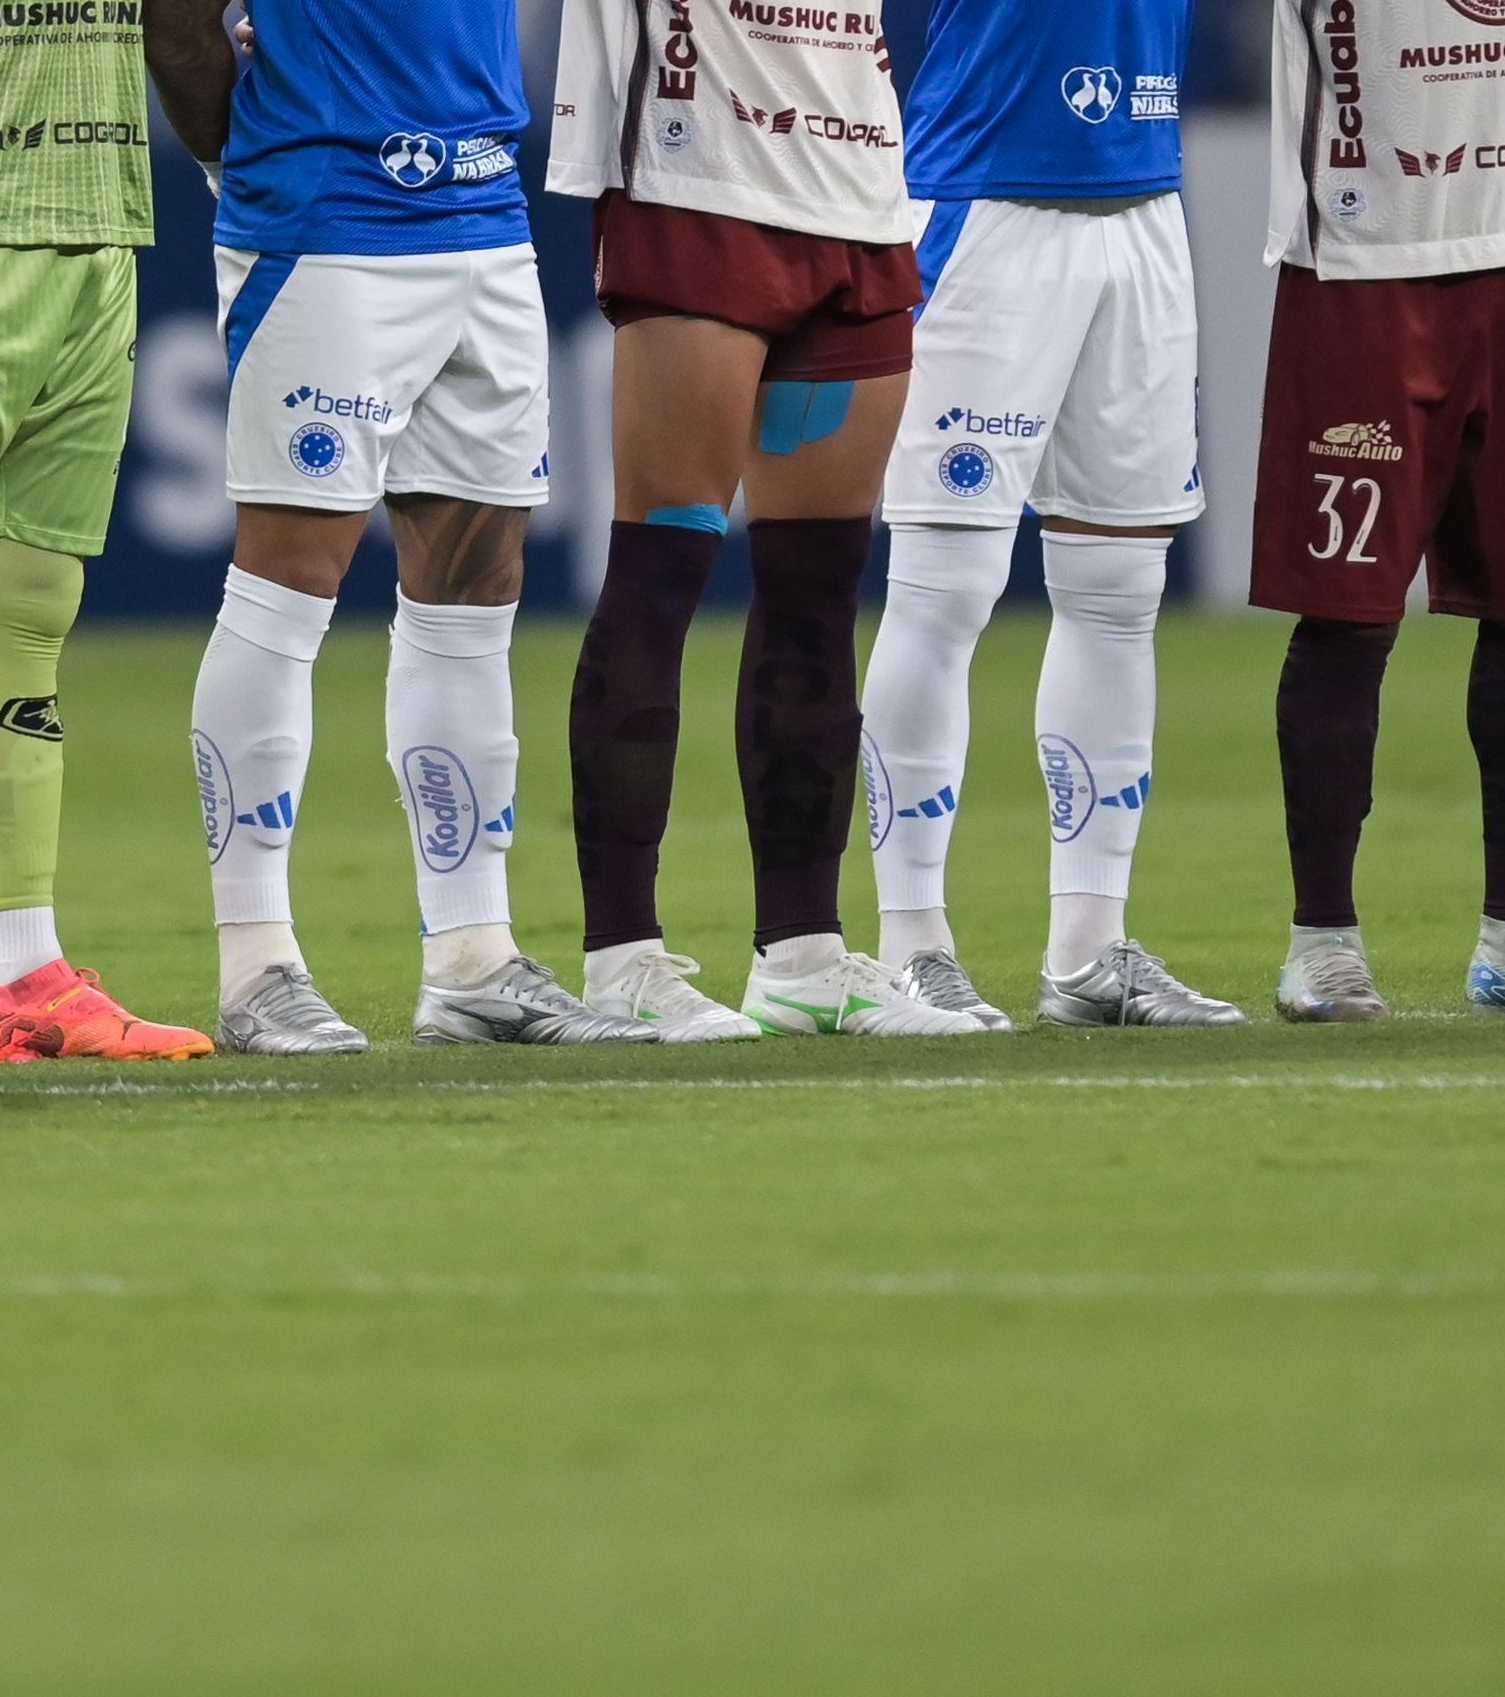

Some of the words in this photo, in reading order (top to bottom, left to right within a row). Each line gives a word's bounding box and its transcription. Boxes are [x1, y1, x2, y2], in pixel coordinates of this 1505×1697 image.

[844, 13, 875, 36] RU
[1422, 72, 1485, 84] COOPERATIVA
[314, 387, 393, 425] betfair
[296, 424, 340, 443] CRUZEIRO
[965, 408, 1047, 438] betfair
[291, 443, 321, 475] ESPORTE
[323, 446, 343, 475] CLUBE
[946, 445, 990, 464] CRUZEIRO
[1308, 440, 1403, 462] MushucAuto
[941, 463, 971, 495] ESPORTE
[972, 467, 992, 494] CLUBE
[1307, 472, 1382, 564] 32
[1039, 744, 1073, 832] Kodilar
[417, 753, 460, 859] Kodilar
